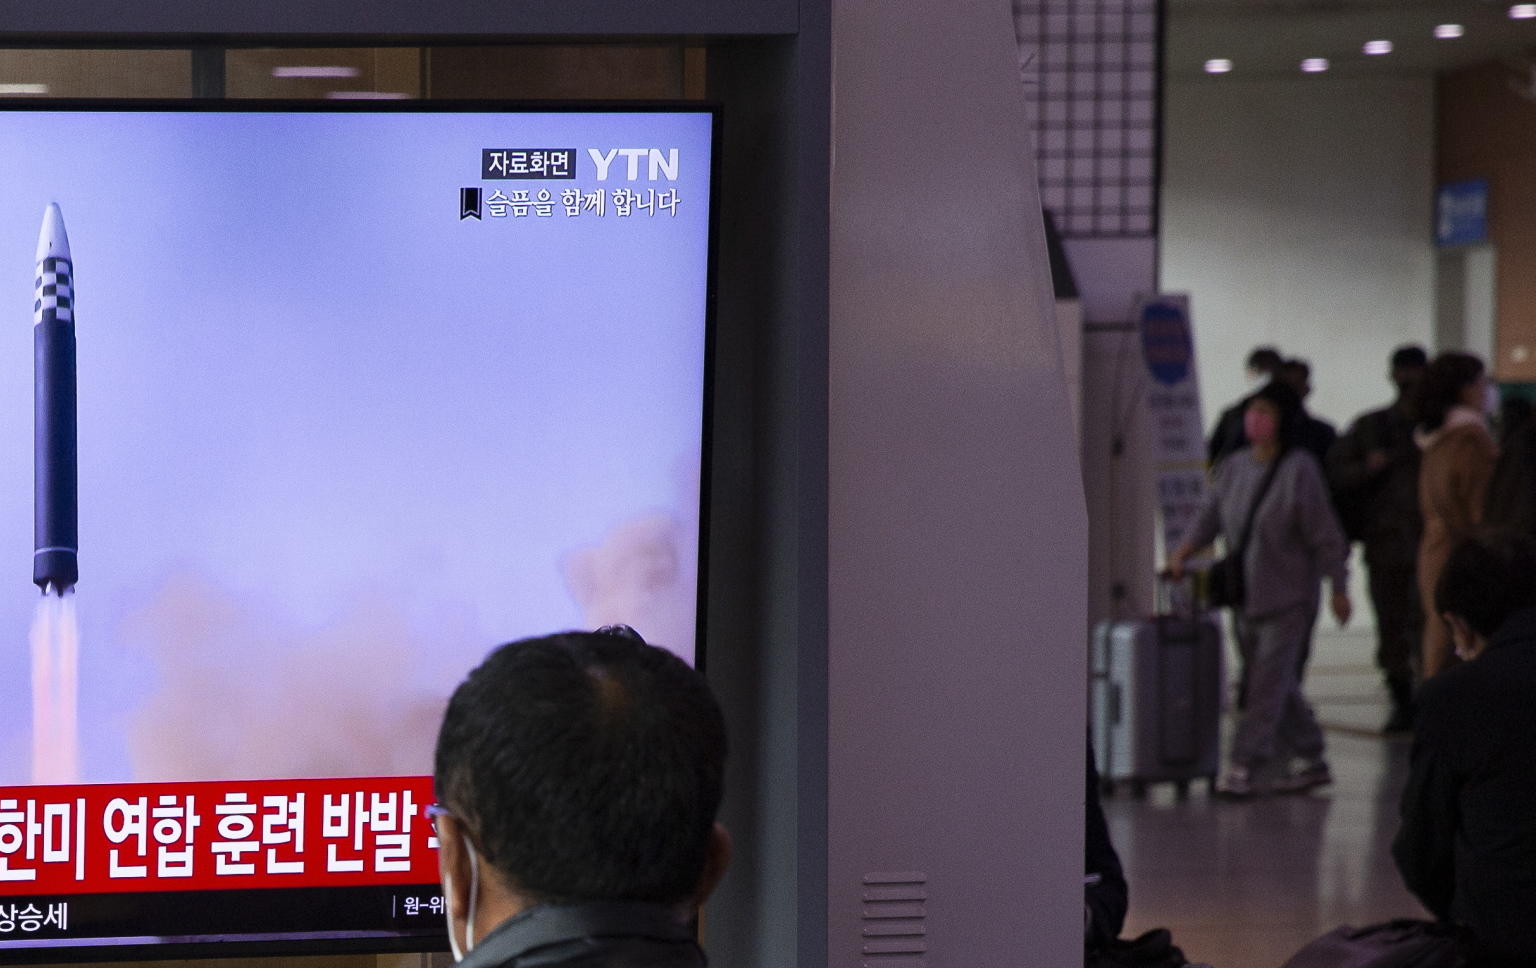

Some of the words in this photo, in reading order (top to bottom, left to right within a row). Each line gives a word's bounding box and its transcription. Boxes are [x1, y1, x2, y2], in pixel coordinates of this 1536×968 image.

[488, 150, 569, 177] 자료화면
[587, 148, 680, 182] YTN
[485, 188, 557, 217] 슬픔을
[560, 187, 607, 217] 함께
[611, 187, 681, 217] 합니다
[103, 795, 201, 878] 연합
[211, 792, 305, 875] 훈련
[322, 790, 418, 872] 반발
[403, 896, 447, 915] 원-위
